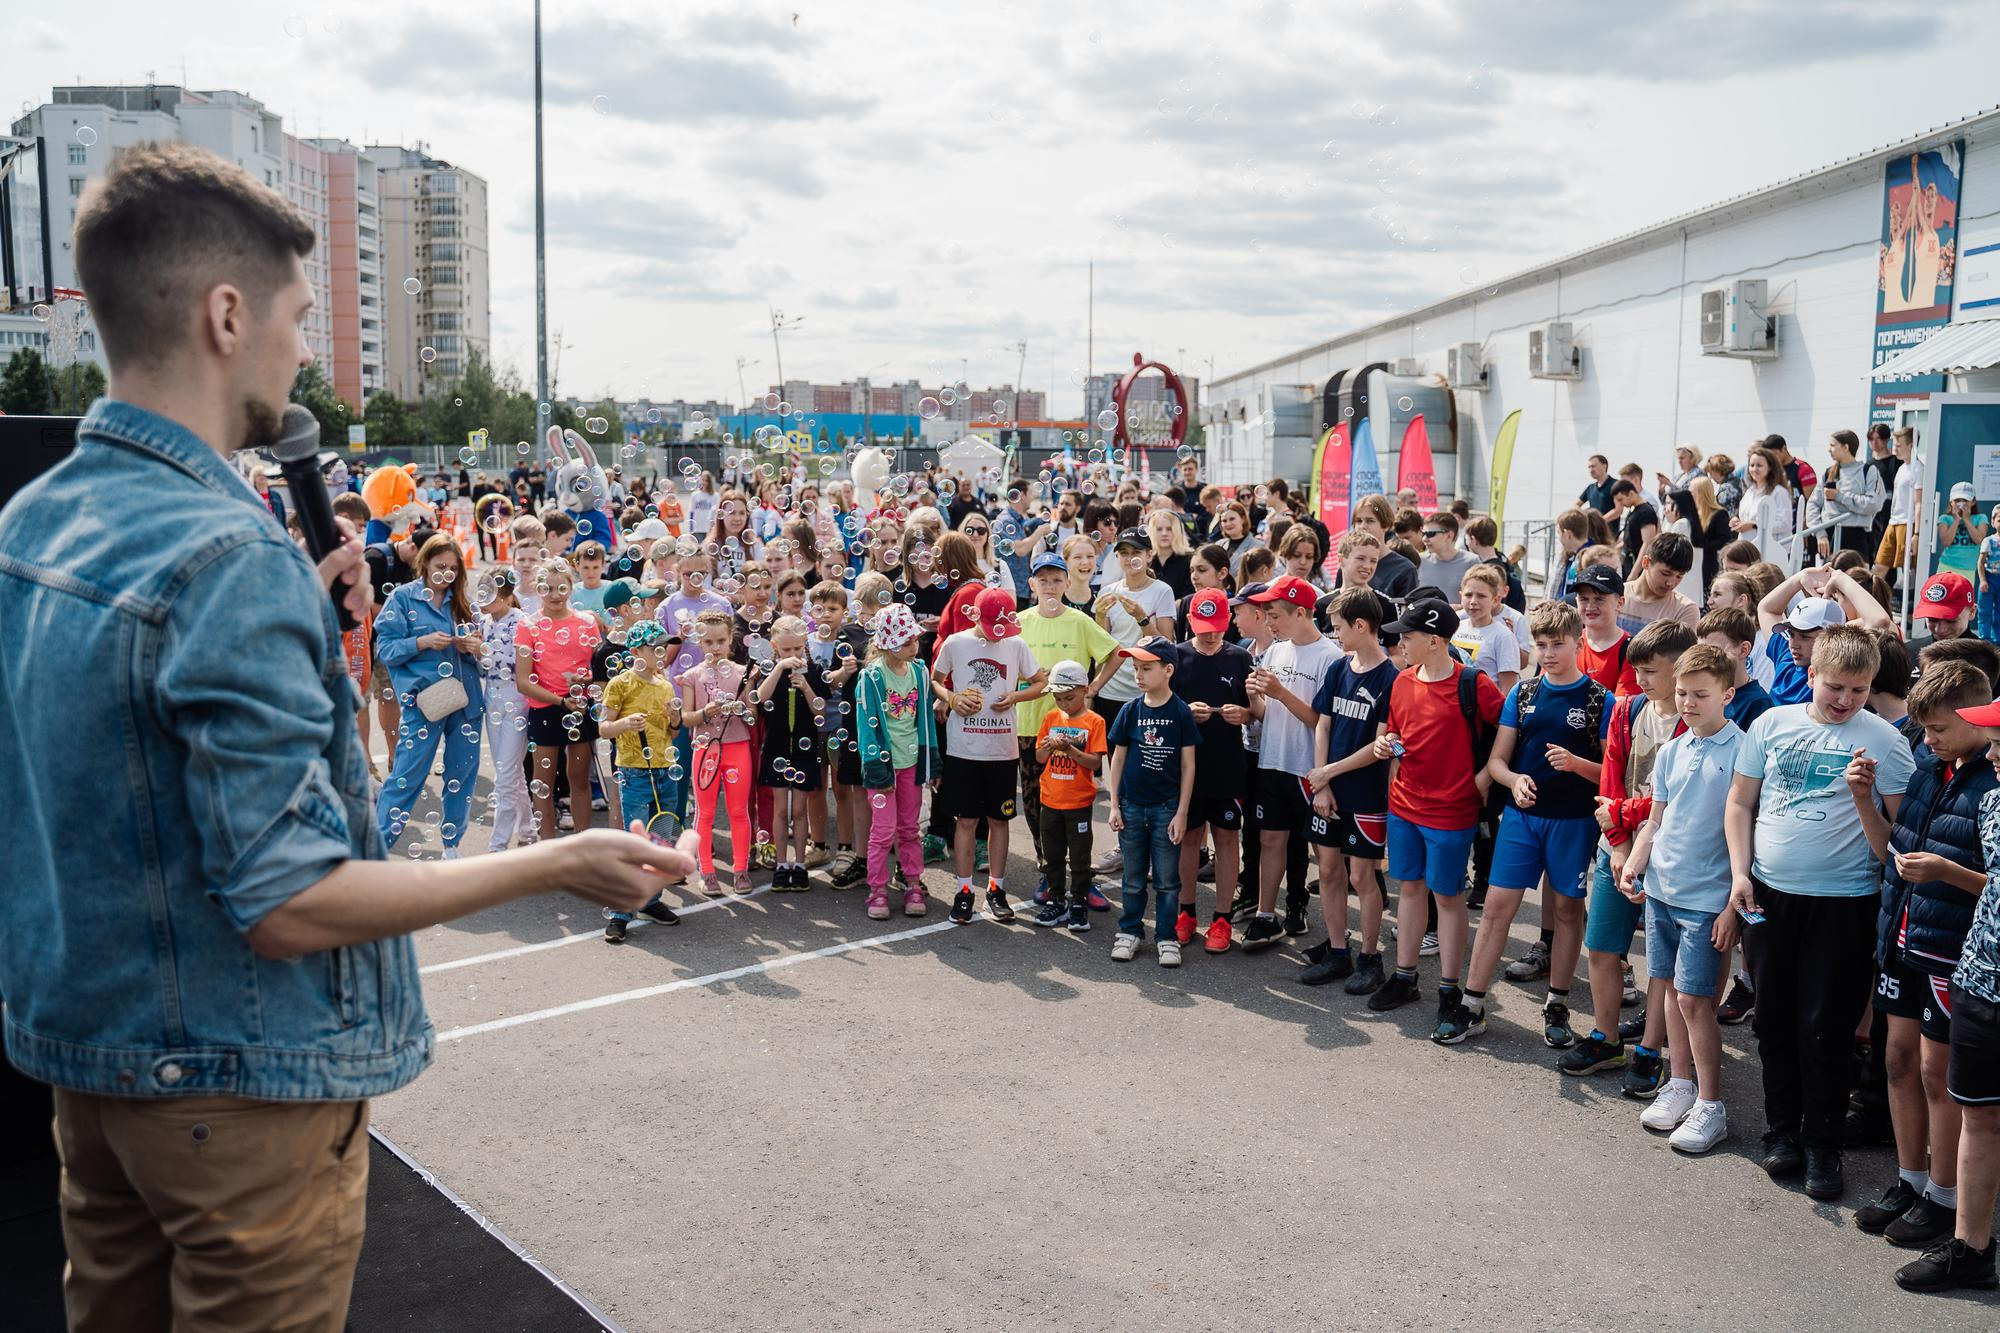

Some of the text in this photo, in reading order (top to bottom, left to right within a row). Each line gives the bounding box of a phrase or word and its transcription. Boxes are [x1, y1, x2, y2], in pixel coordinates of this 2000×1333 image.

[1288, 587, 1297, 598] 6
[1424, 609, 1439, 628] 2
[1332, 696, 1371, 721] PUMA
[1256, 804, 1264, 819] 6
[1311, 815, 1327, 835] 99
[1877, 972, 1900, 1000] 35
